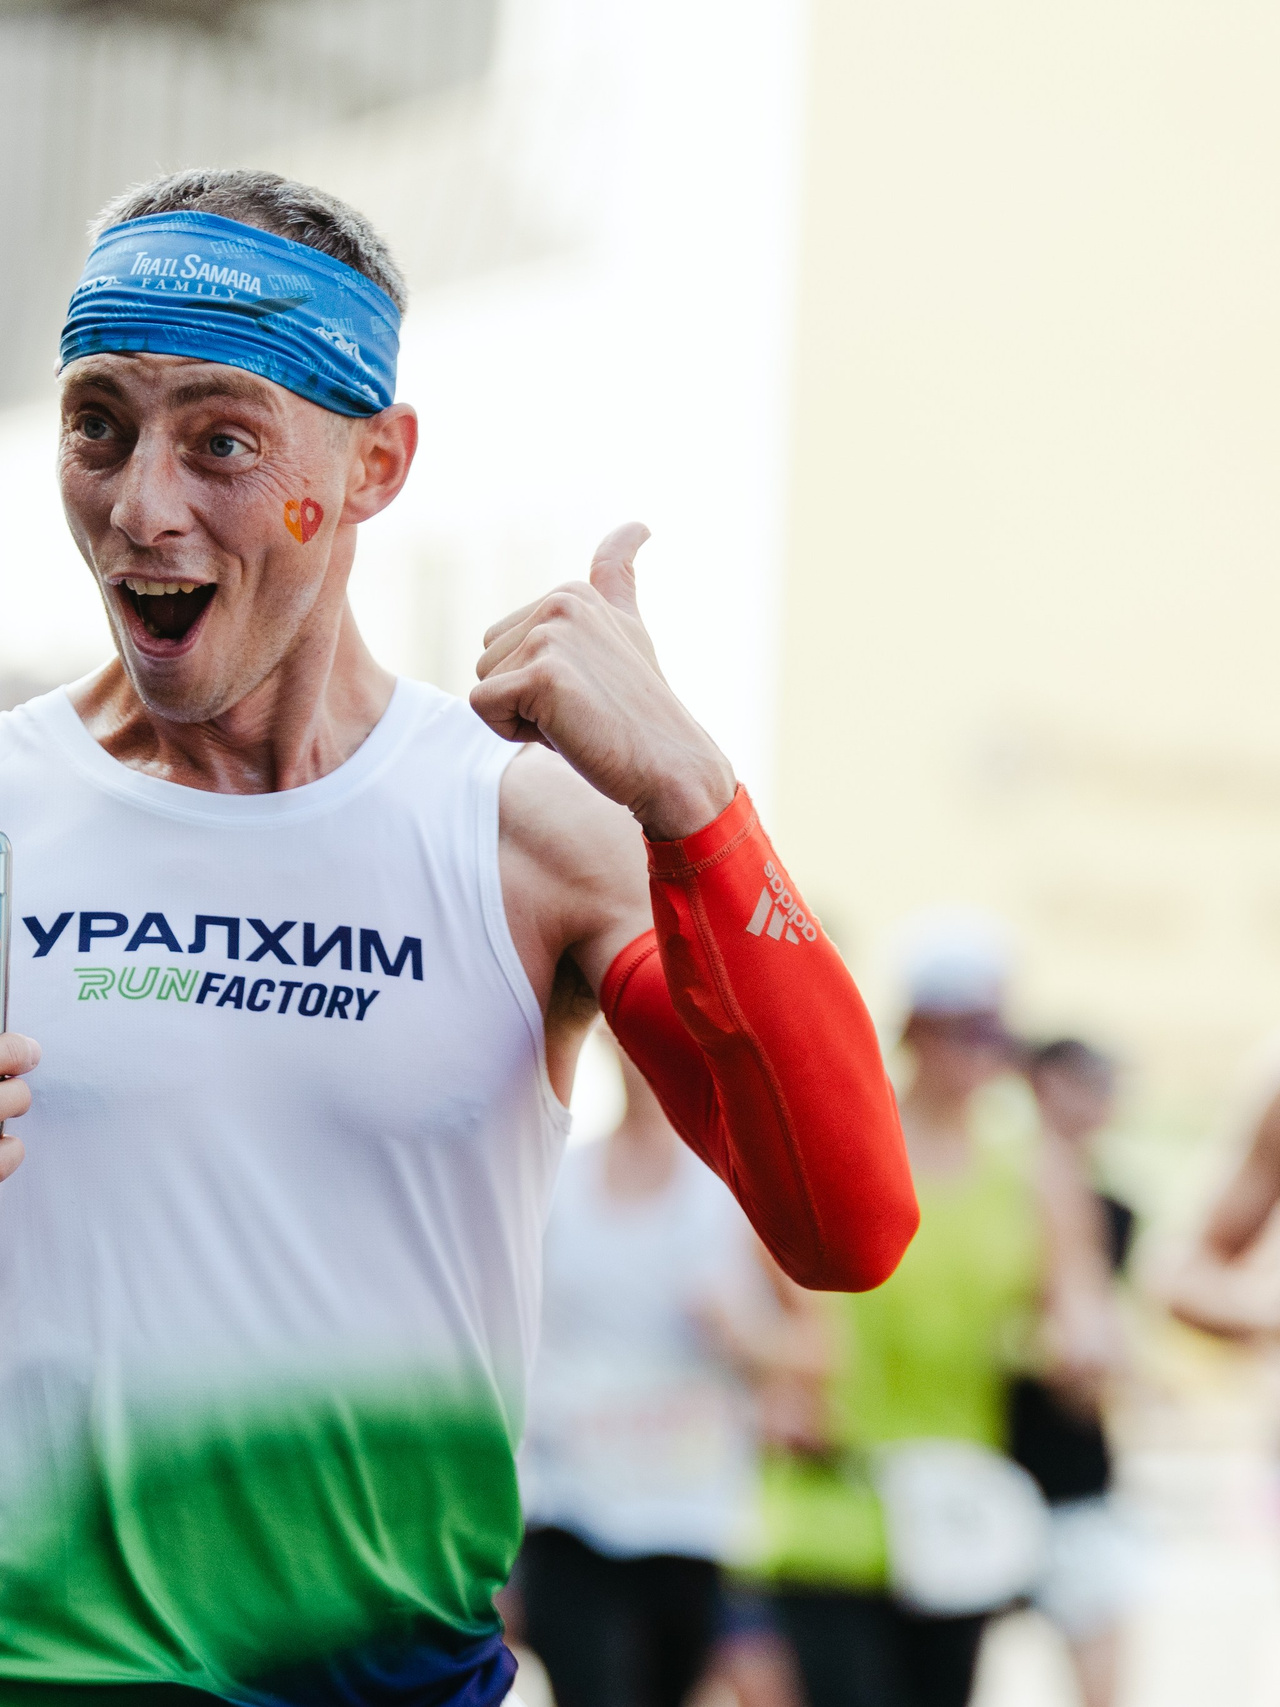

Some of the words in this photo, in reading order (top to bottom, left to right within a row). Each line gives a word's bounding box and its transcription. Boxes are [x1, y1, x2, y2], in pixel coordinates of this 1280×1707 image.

[130, 251, 178, 278] TRAIL
[180, 254, 262, 296] SAMARA
[141, 277, 238, 300] FAMILY
[763, 859, 818, 943] adidas
[22, 911, 424, 982] УРАЛХИМ
